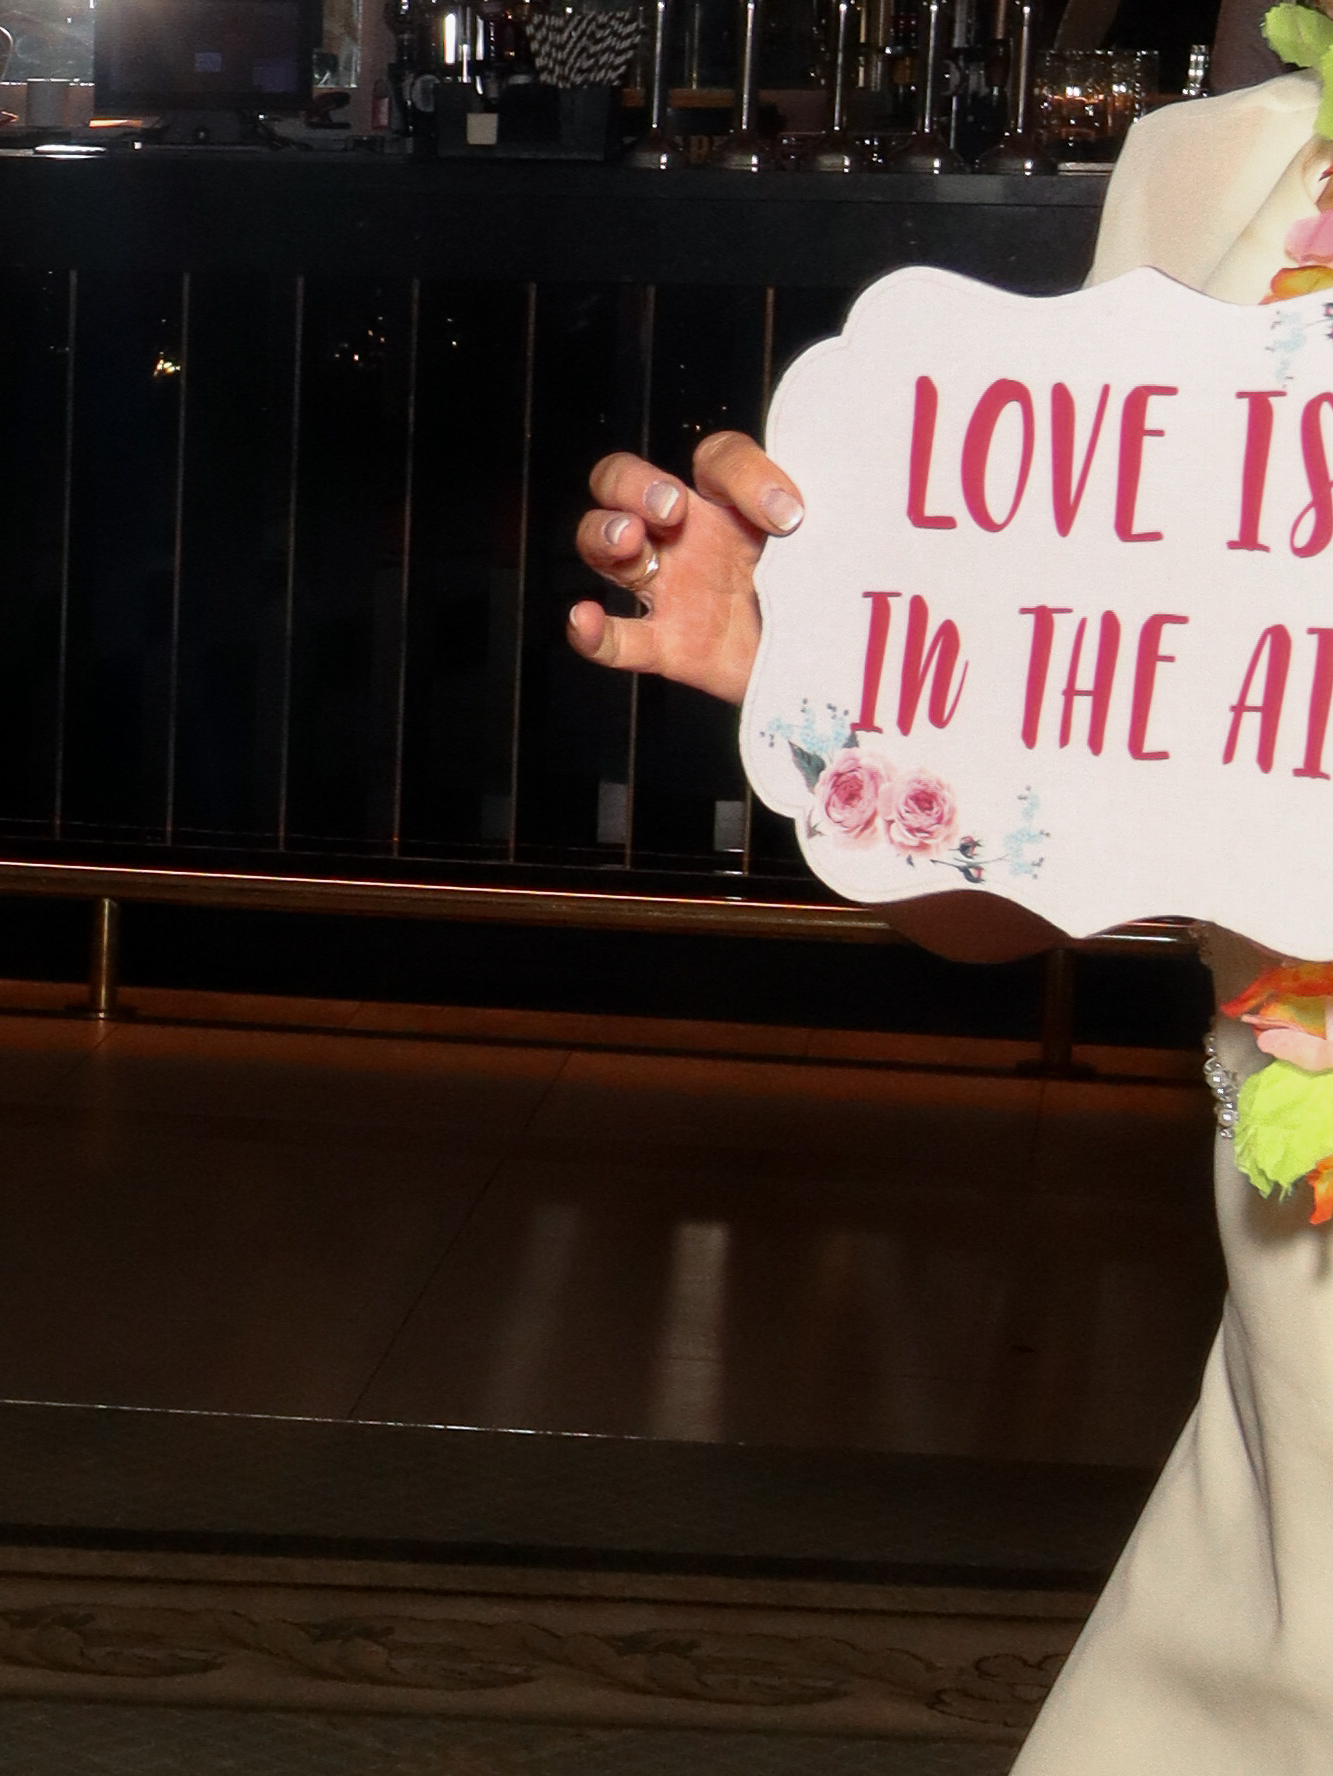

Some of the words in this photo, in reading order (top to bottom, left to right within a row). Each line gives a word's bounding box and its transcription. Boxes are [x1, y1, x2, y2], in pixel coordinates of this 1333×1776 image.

[906, 376, 1178, 542] LOVE
[1227, 390, 1333, 556] IS
[850, 592, 969, 736] IN
[1019, 604, 1189, 760] THE
